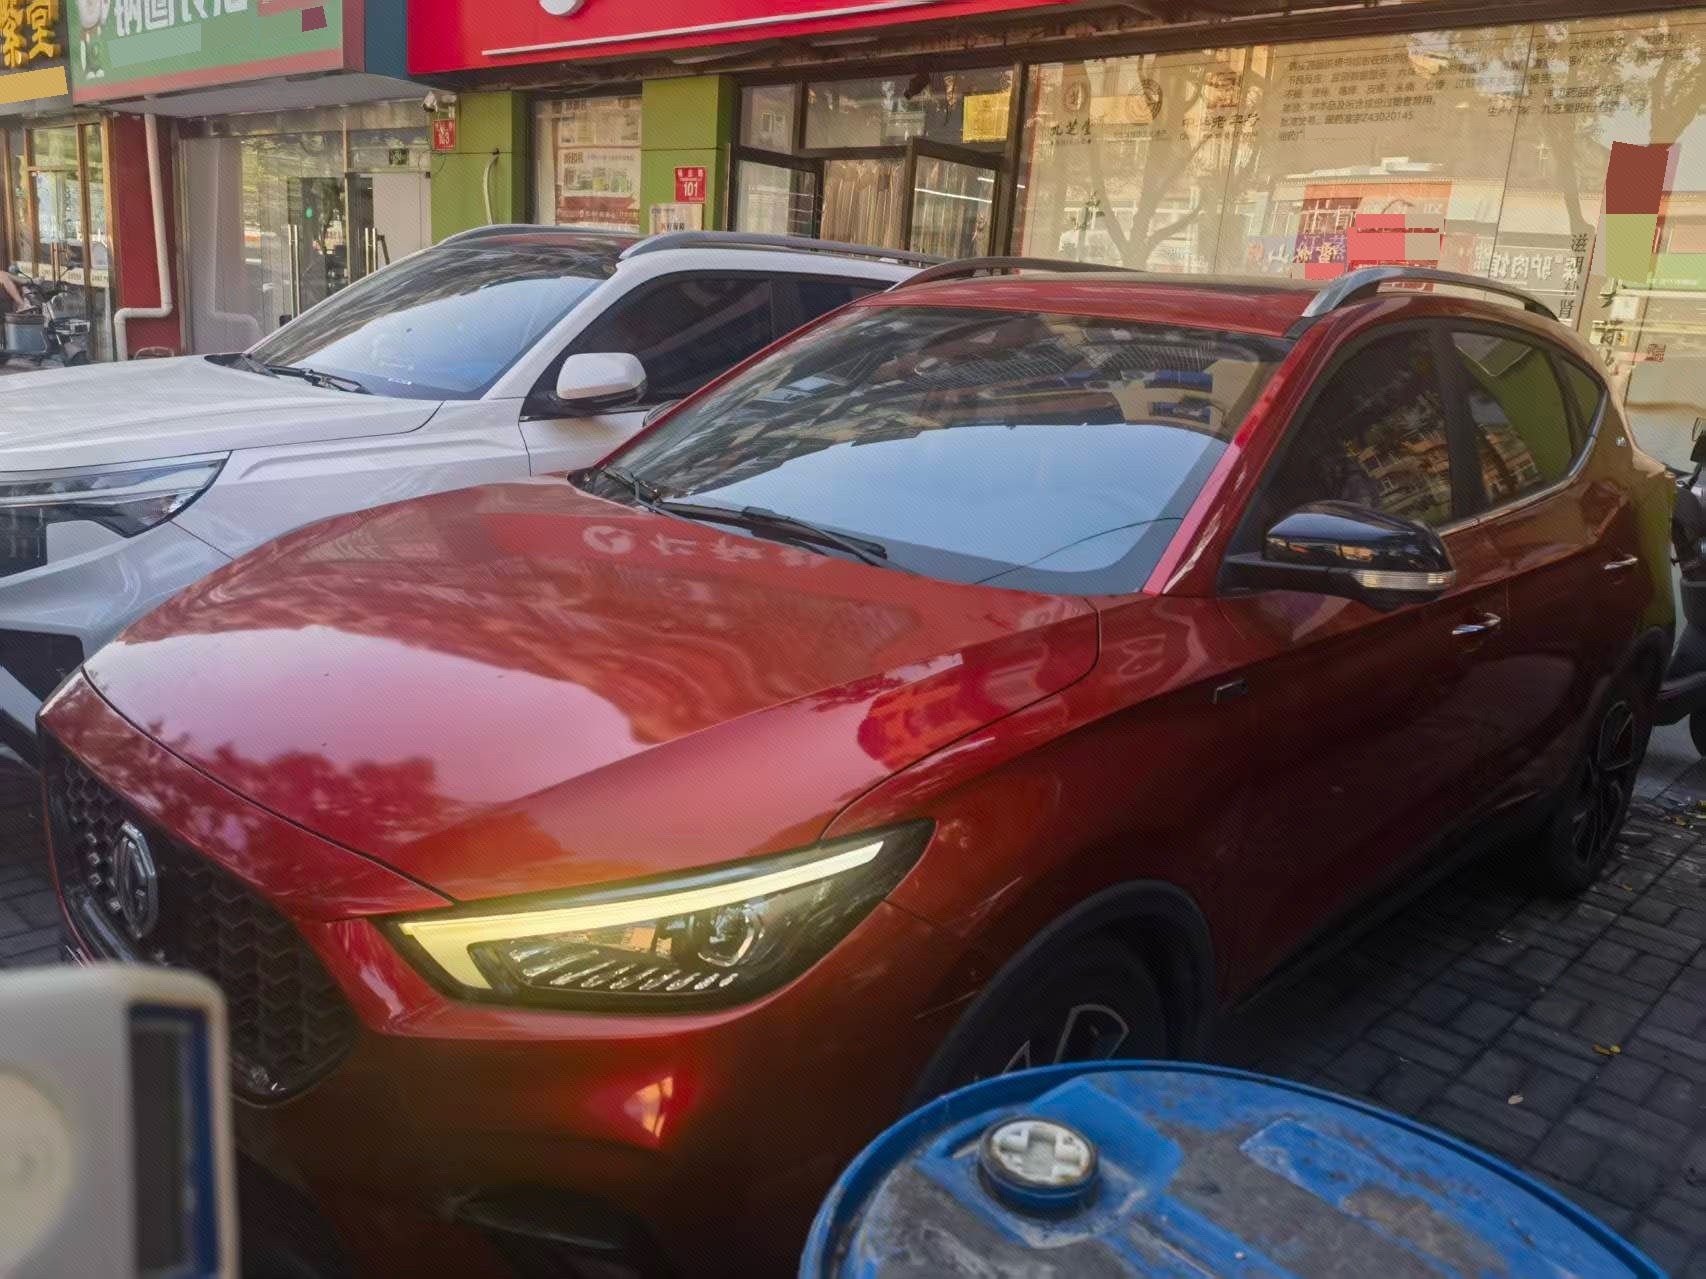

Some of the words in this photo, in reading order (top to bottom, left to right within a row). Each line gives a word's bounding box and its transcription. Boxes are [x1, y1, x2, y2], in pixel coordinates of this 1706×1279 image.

[1050, 117, 1091, 136] 九芝堂
[683, 181, 698, 197] 101
